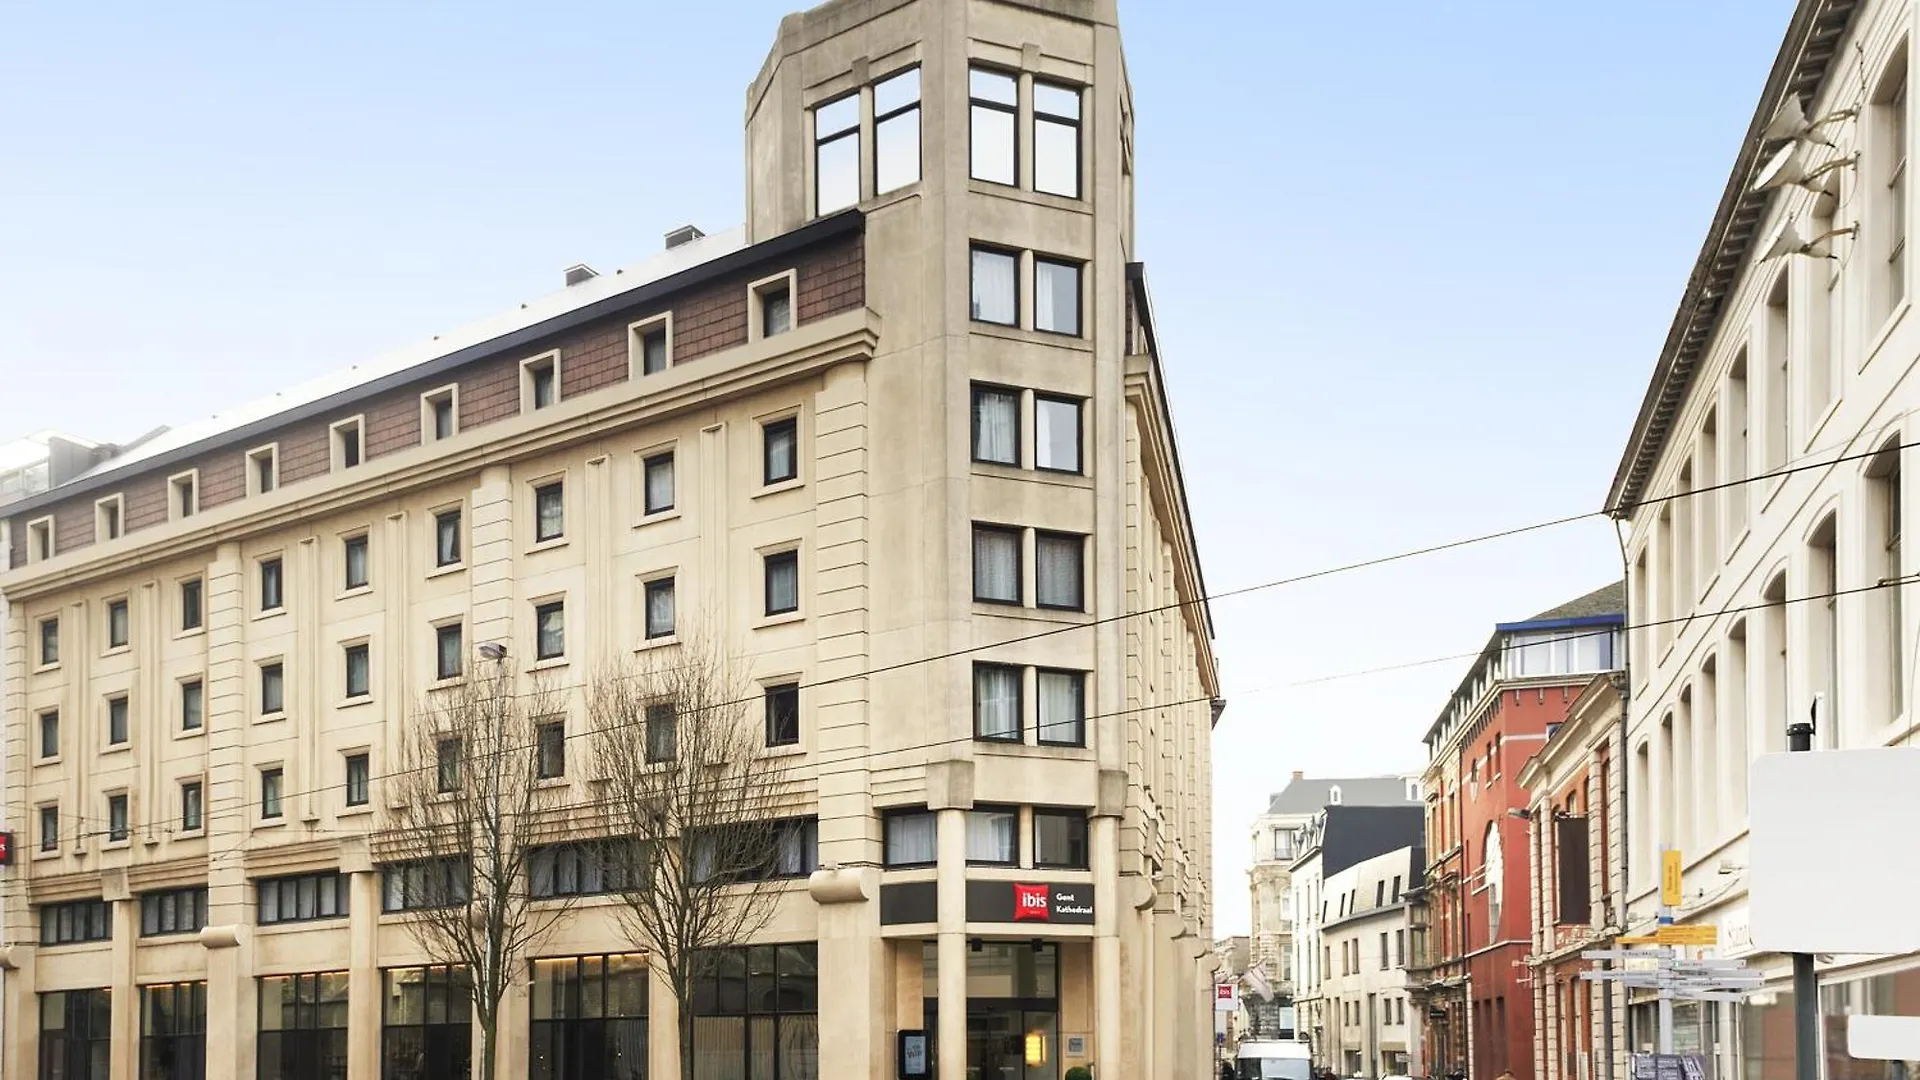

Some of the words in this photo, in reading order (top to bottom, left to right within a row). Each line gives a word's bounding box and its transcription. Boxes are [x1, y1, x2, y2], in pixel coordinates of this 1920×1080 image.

[1022, 892, 1047, 908] ibis
[1056, 892, 1075, 902] Gent
[1056, 905, 1093, 914] Kathedraal
